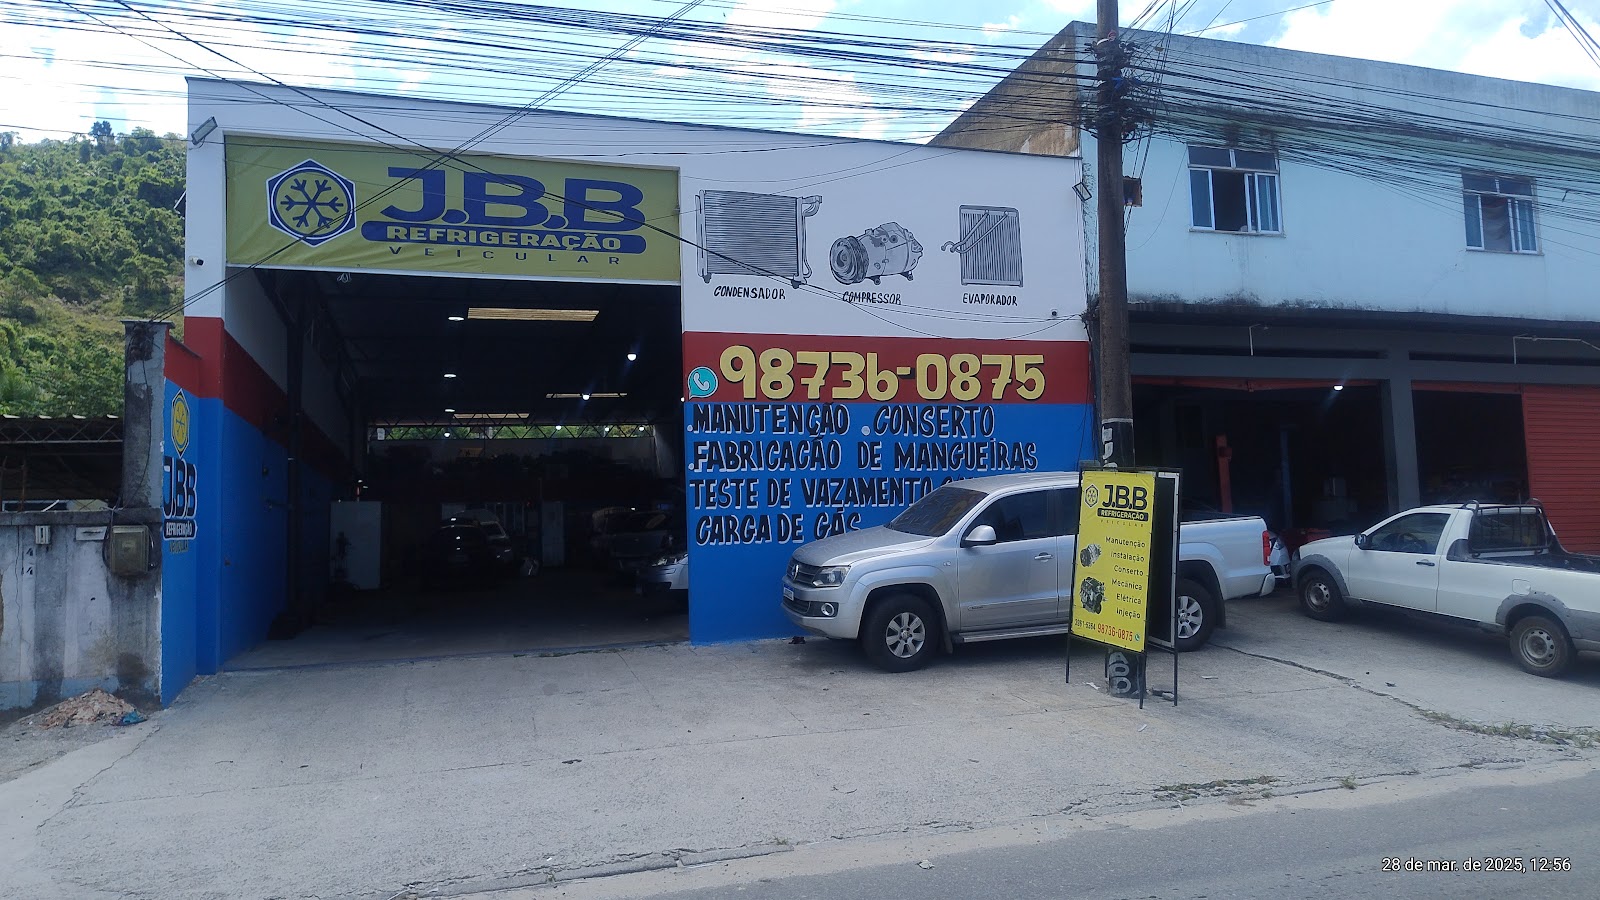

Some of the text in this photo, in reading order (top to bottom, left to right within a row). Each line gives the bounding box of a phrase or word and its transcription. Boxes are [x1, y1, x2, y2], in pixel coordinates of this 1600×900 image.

[380, 166, 646, 232] J.B.B
[387, 225, 622, 251] REFRIGERAÇÃO
[389, 246, 620, 265] VEICULAR
[713, 285, 787, 301] CONDENSADOR
[842, 291, 902, 305] COMPRESSOR
[962, 292, 1019, 307] EVAPORADOR
[719, 345, 1046, 401] 98736-0875
[692, 401, 996, 438] MANUTENÇÃO CONSERTO
[857, 441, 883, 472] DE
[894, 437, 1038, 472] MANGUEIRAS
[688, 476, 934, 510] TESTE DE VAZAMENTO
[1102, 484, 1149, 510] J.B.B
[1100, 509, 1145, 521] REFRIGERAÇÃO
[695, 514, 773, 547] CARGA
[777, 513, 805, 544] DE
[1105, 536, 1146, 549] Manutenção
[1110, 551, 1145, 563] Instalação
[1113, 564, 1144, 577] Conserto
[1111, 578, 1143, 591] Mecânica
[1116, 593, 1142, 605] Elétrica
[1116, 607, 1141, 620] Injeção
[1097, 623, 1133, 642] 98736-0875
